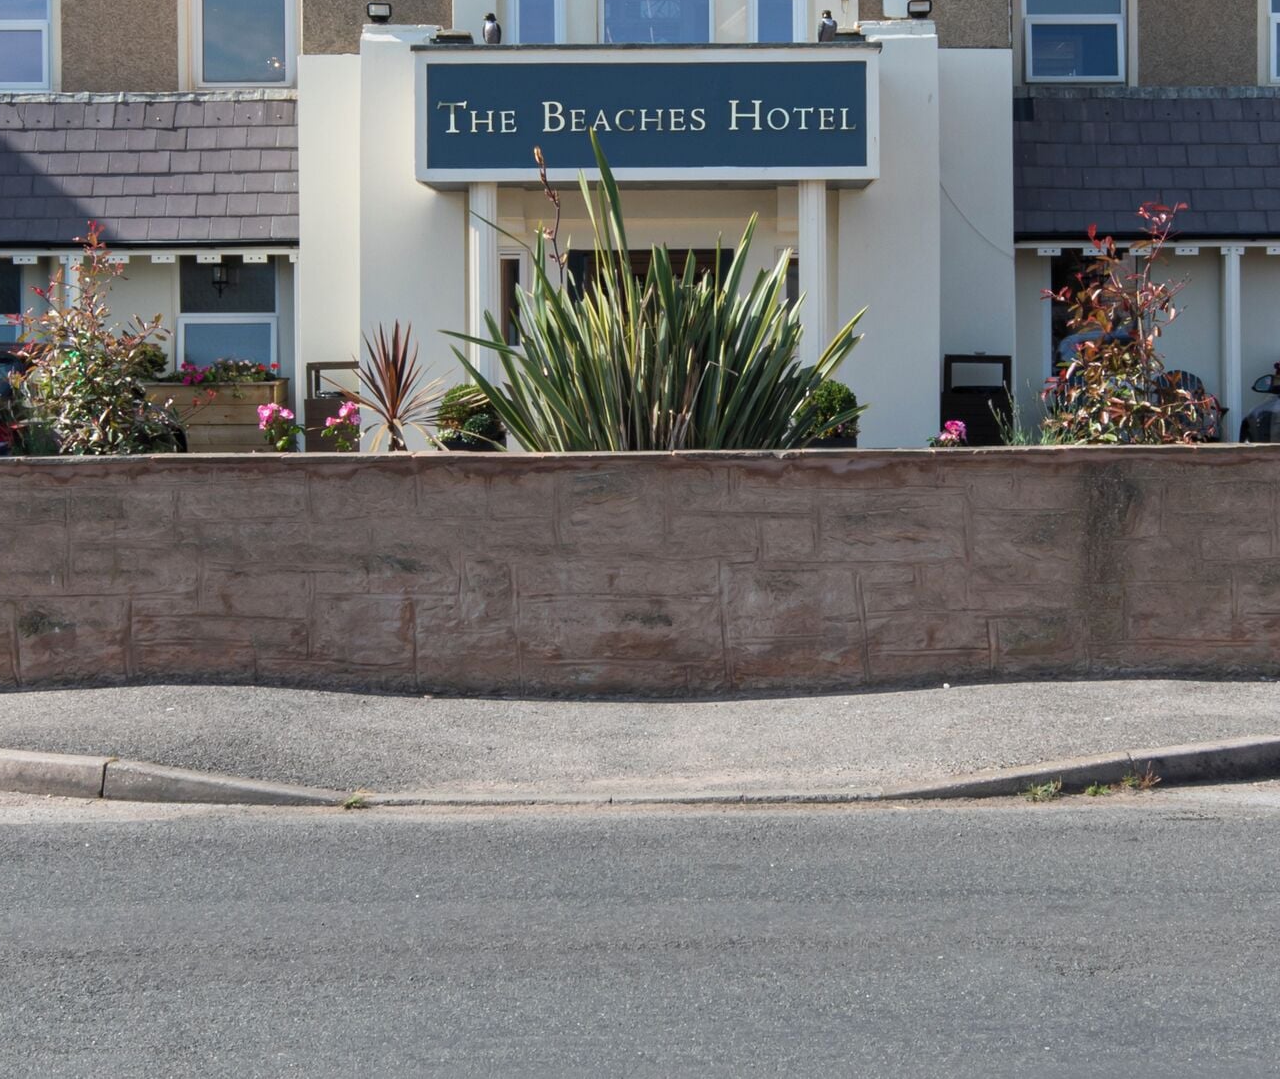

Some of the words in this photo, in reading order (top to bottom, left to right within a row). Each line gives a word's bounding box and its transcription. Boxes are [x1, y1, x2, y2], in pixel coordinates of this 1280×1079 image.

[436, 100, 518, 134] THE
[541, 100, 707, 133] BEACHES
[727, 99, 857, 132] HOTEL
